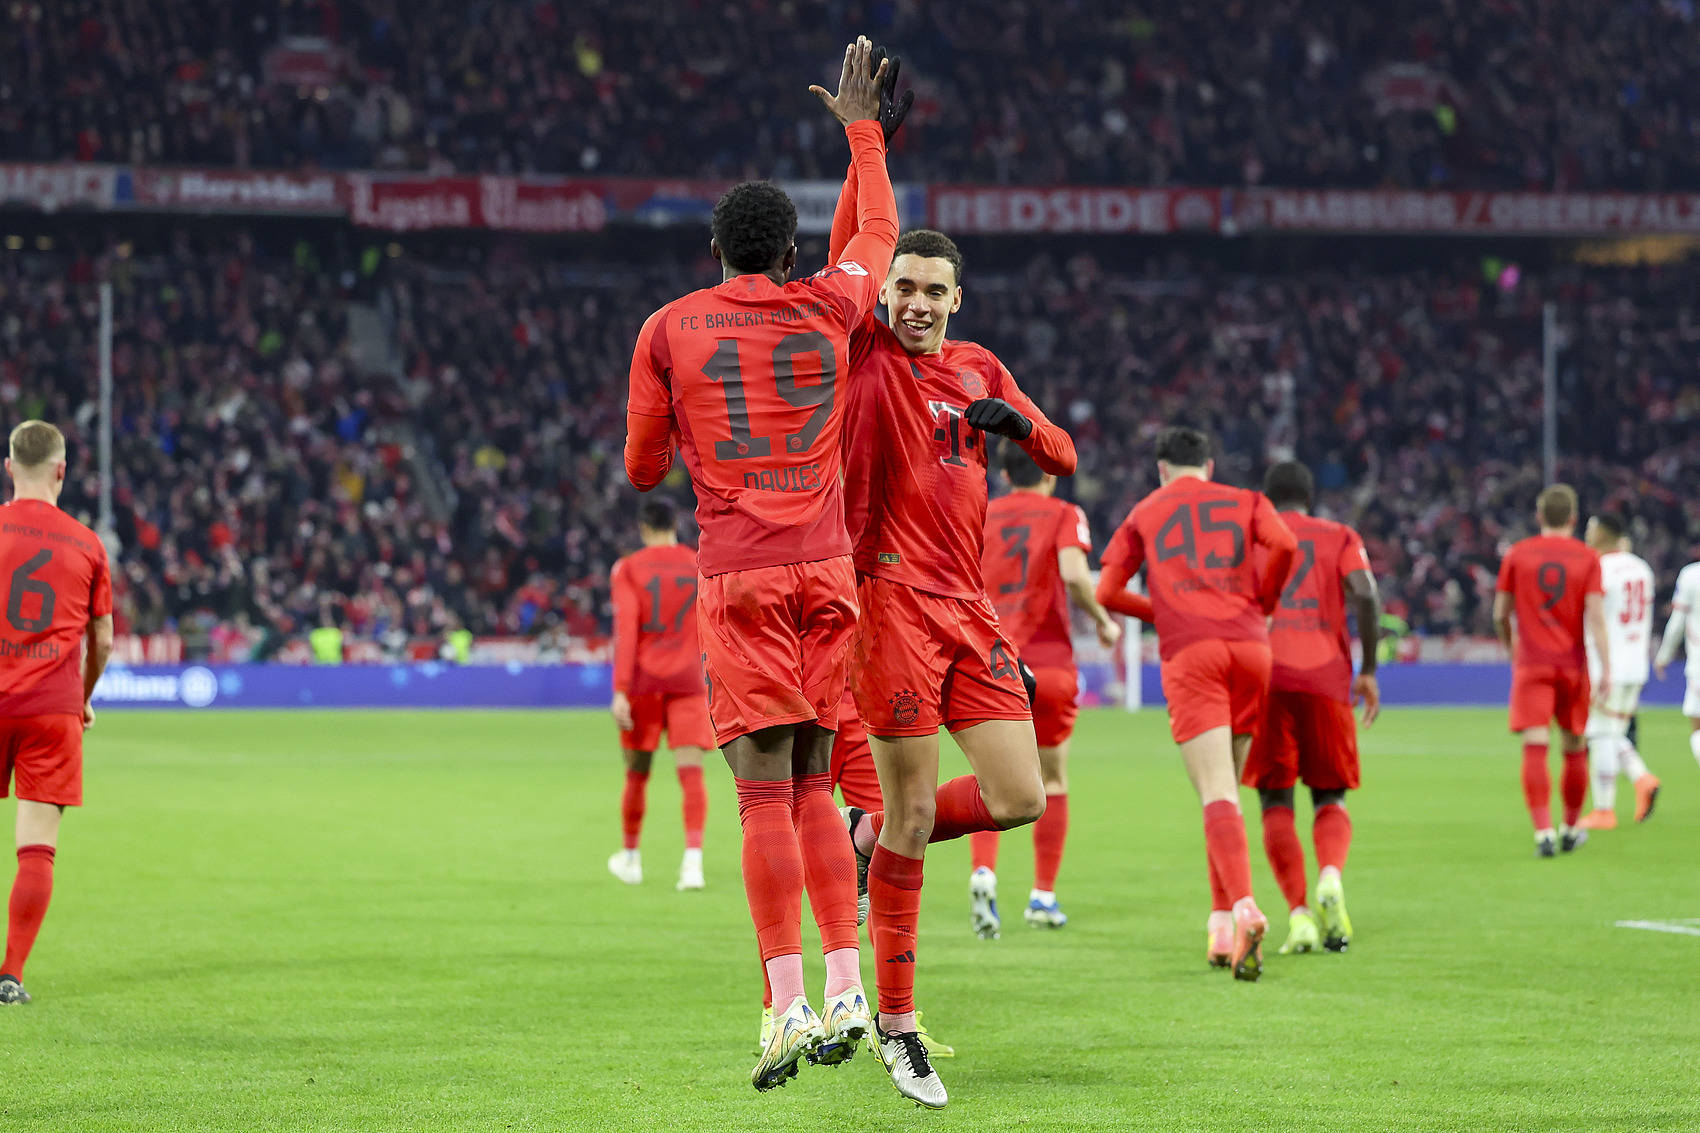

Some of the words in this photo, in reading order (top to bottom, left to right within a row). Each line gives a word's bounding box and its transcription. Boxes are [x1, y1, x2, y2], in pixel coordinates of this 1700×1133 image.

[936, 191, 1168, 231] REDSIDE
[681, 315, 699, 330] FC
[705, 311, 764, 329] BAYERN
[700, 331, 836, 460] 19
[743, 463, 821, 492] DAVIES
[999, 525, 1030, 594] 3
[1154, 500, 1245, 569] 45
[6, 548, 56, 634] 6
[642, 574, 698, 633] 17
[1281, 541, 1319, 609] 2
[1537, 562, 1566, 611] 9
[0, 638, 60, 661] IMMICH
